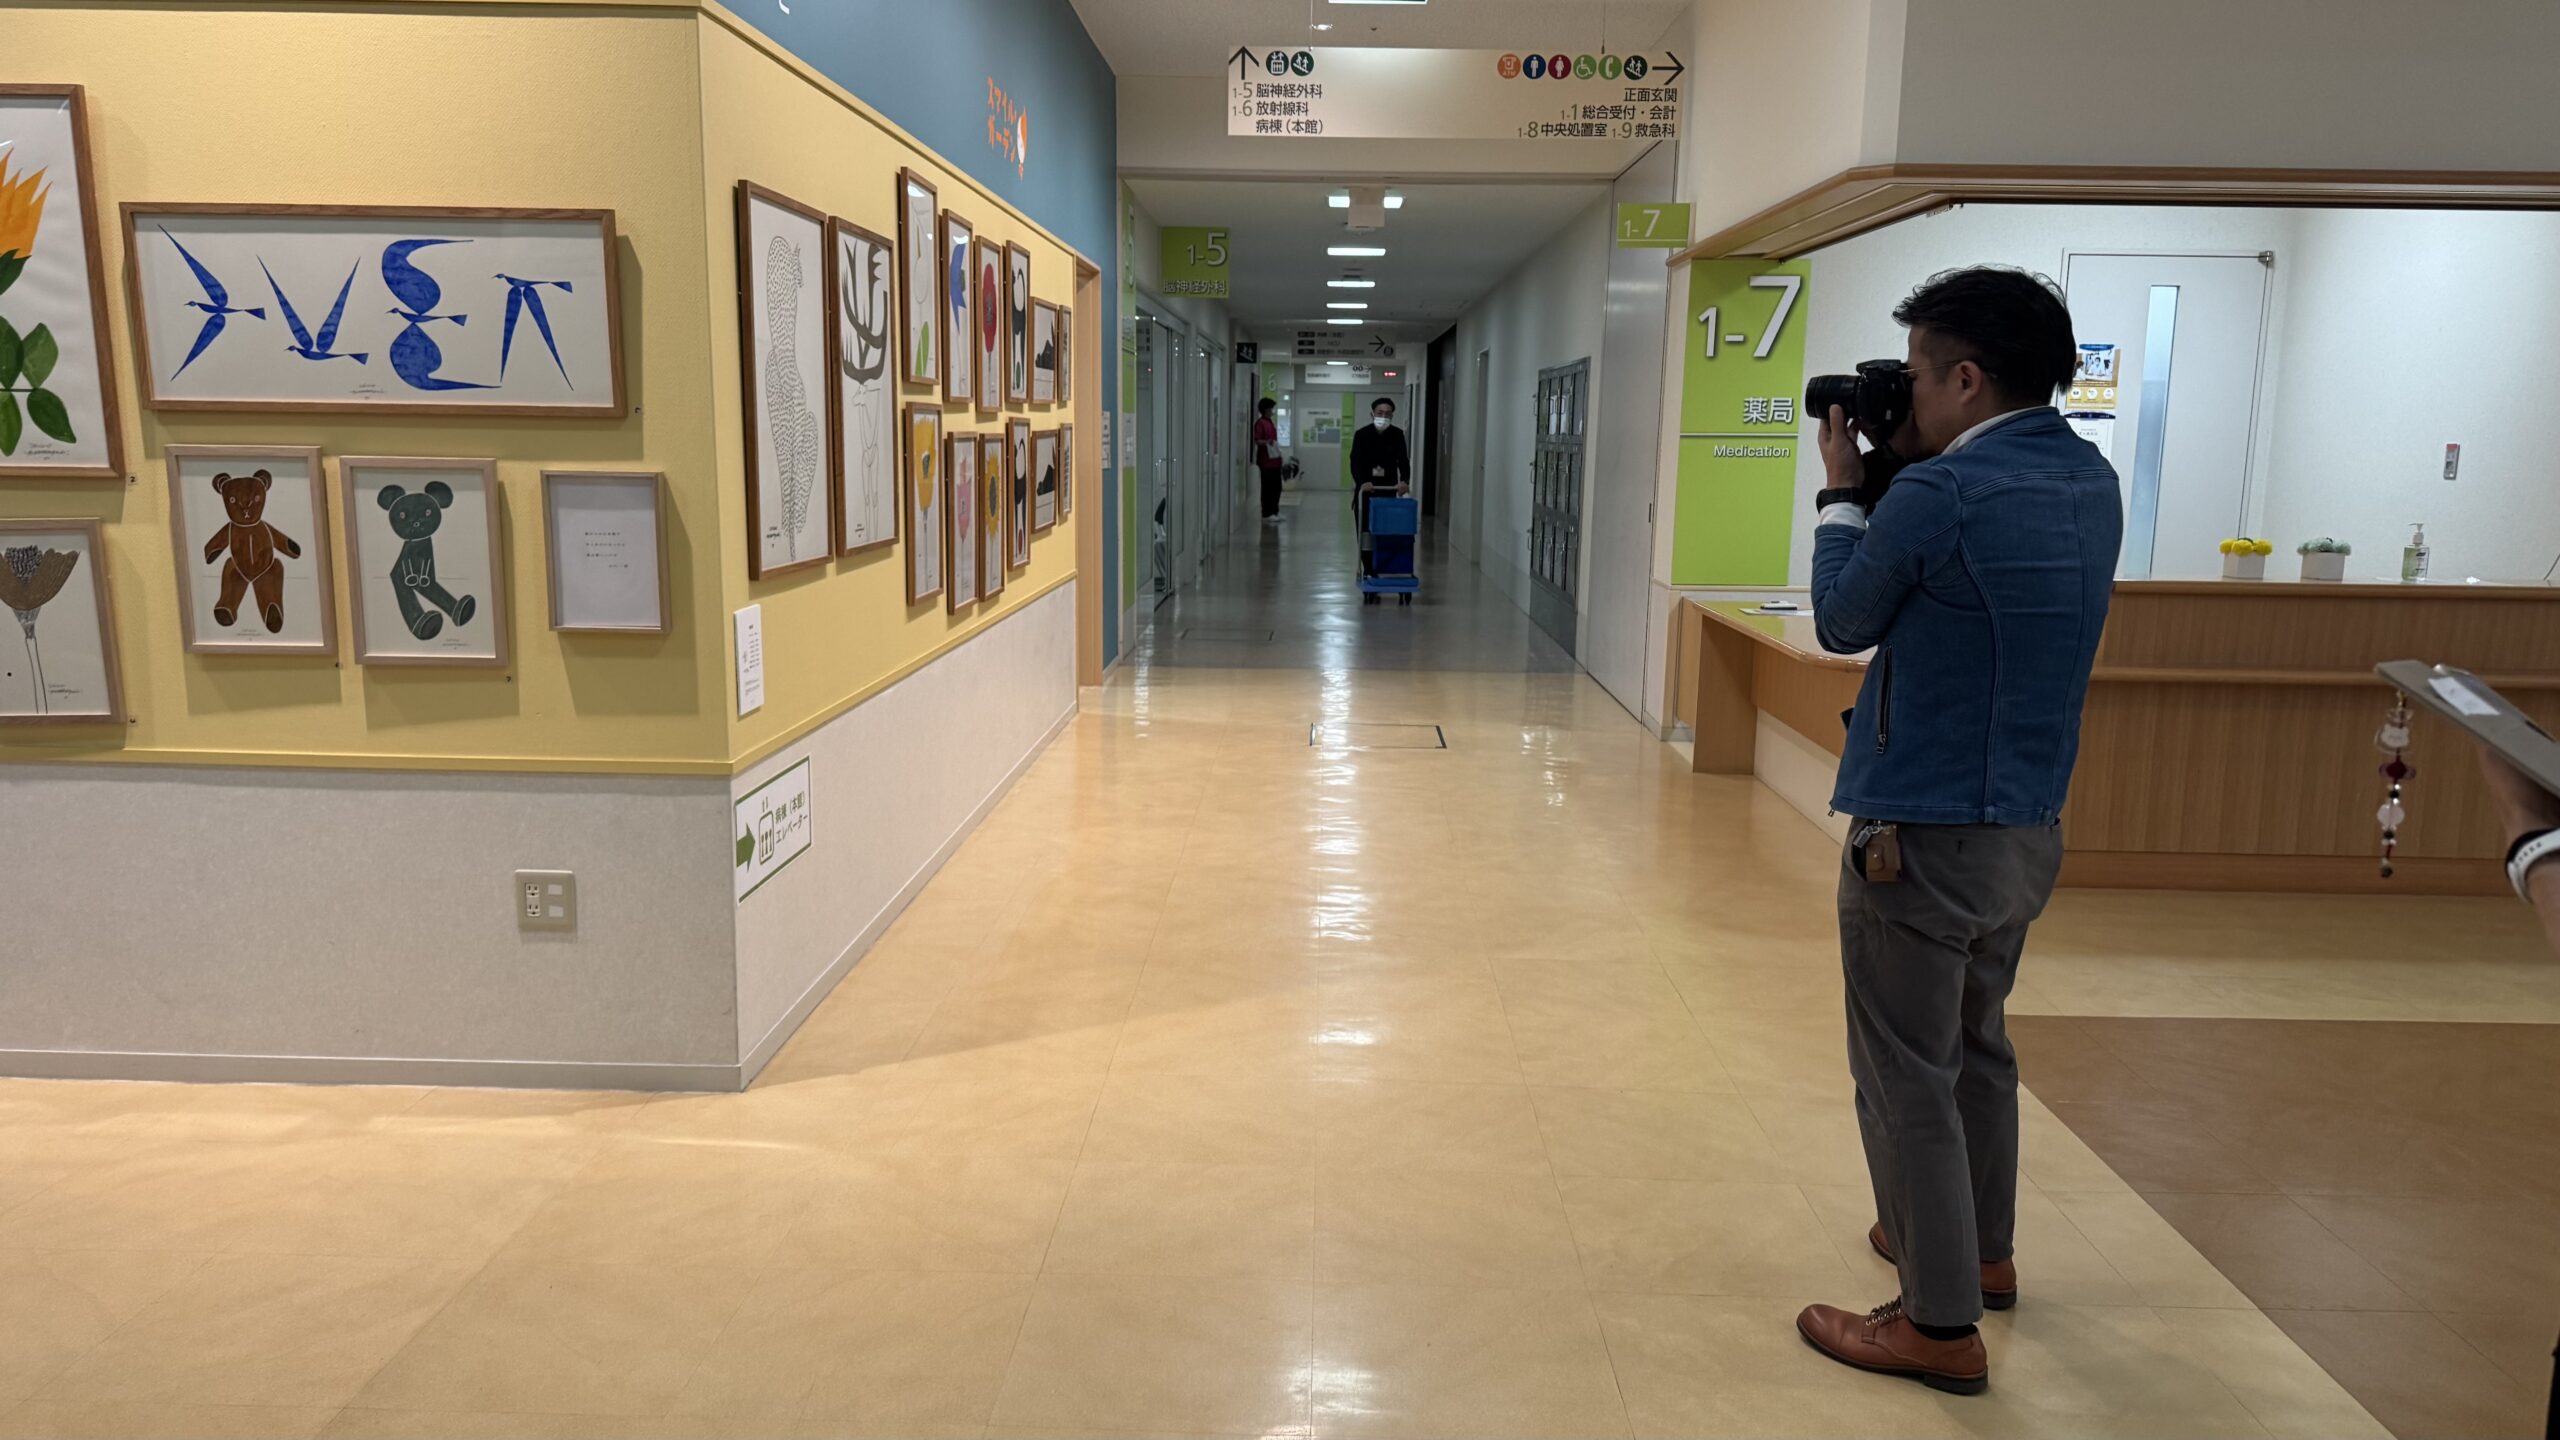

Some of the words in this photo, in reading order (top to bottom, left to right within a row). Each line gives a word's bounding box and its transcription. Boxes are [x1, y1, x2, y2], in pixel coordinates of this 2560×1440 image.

[1233, 82, 1253, 98] 1-5
[1256, 84, 1322, 99] 脳神経外科
[1624, 88, 1678, 102] 正面玄関
[1233, 100, 1253, 117] 1-6
[1256, 102, 1308, 116] 放射線科
[1561, 104, 1577, 120] 1-1
[1582, 106, 1677, 120] 総合受付・会計
[1518, 122, 1538, 138] 1-8
[1541, 123, 1608, 137] 中央処置室
[1612, 122, 1632, 138] 1-9
[1635, 124, 1675, 138] 救急科
[1624, 209, 1661, 238] 1-7
[1186, 232, 1227, 267] 1-5
[1698, 275, 1801, 358] 1-7
[1743, 397, 1795, 424] 薬局
[1713, 445, 1790, 457] Medication
